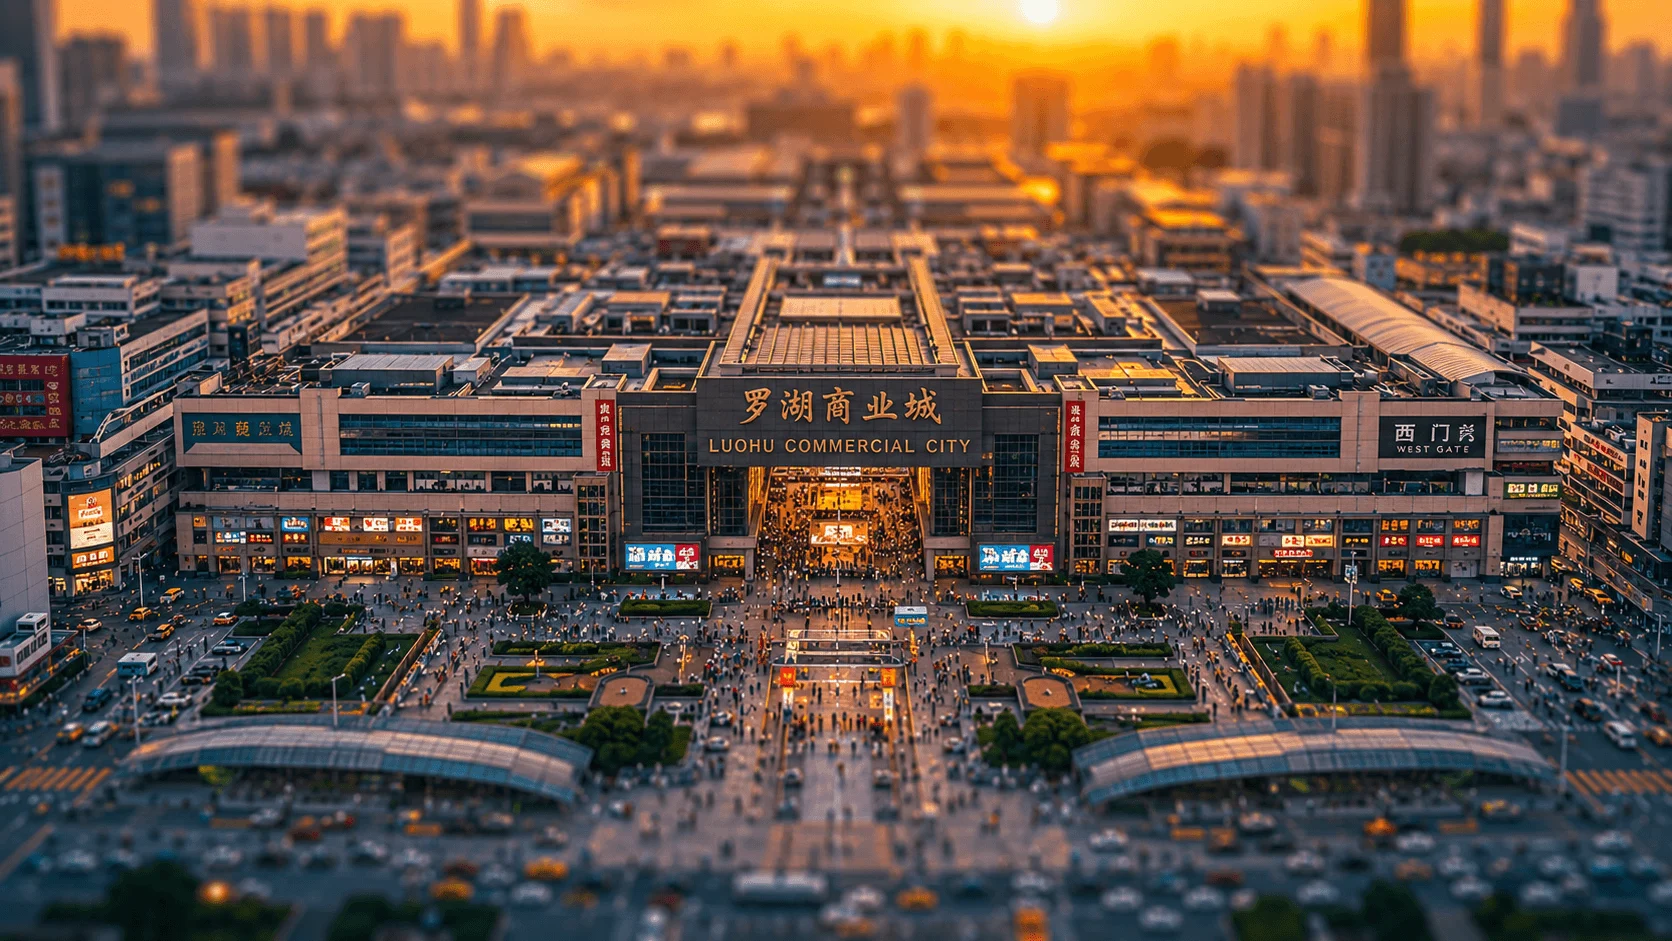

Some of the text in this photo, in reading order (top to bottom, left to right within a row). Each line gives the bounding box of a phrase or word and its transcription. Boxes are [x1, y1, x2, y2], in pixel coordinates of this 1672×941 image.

[740, 386, 942, 425] 罗湖商业城
[709, 438, 971, 453] LUOHU COMMERCIAL CITY
[1396, 445, 1470, 454] WEST GATE
